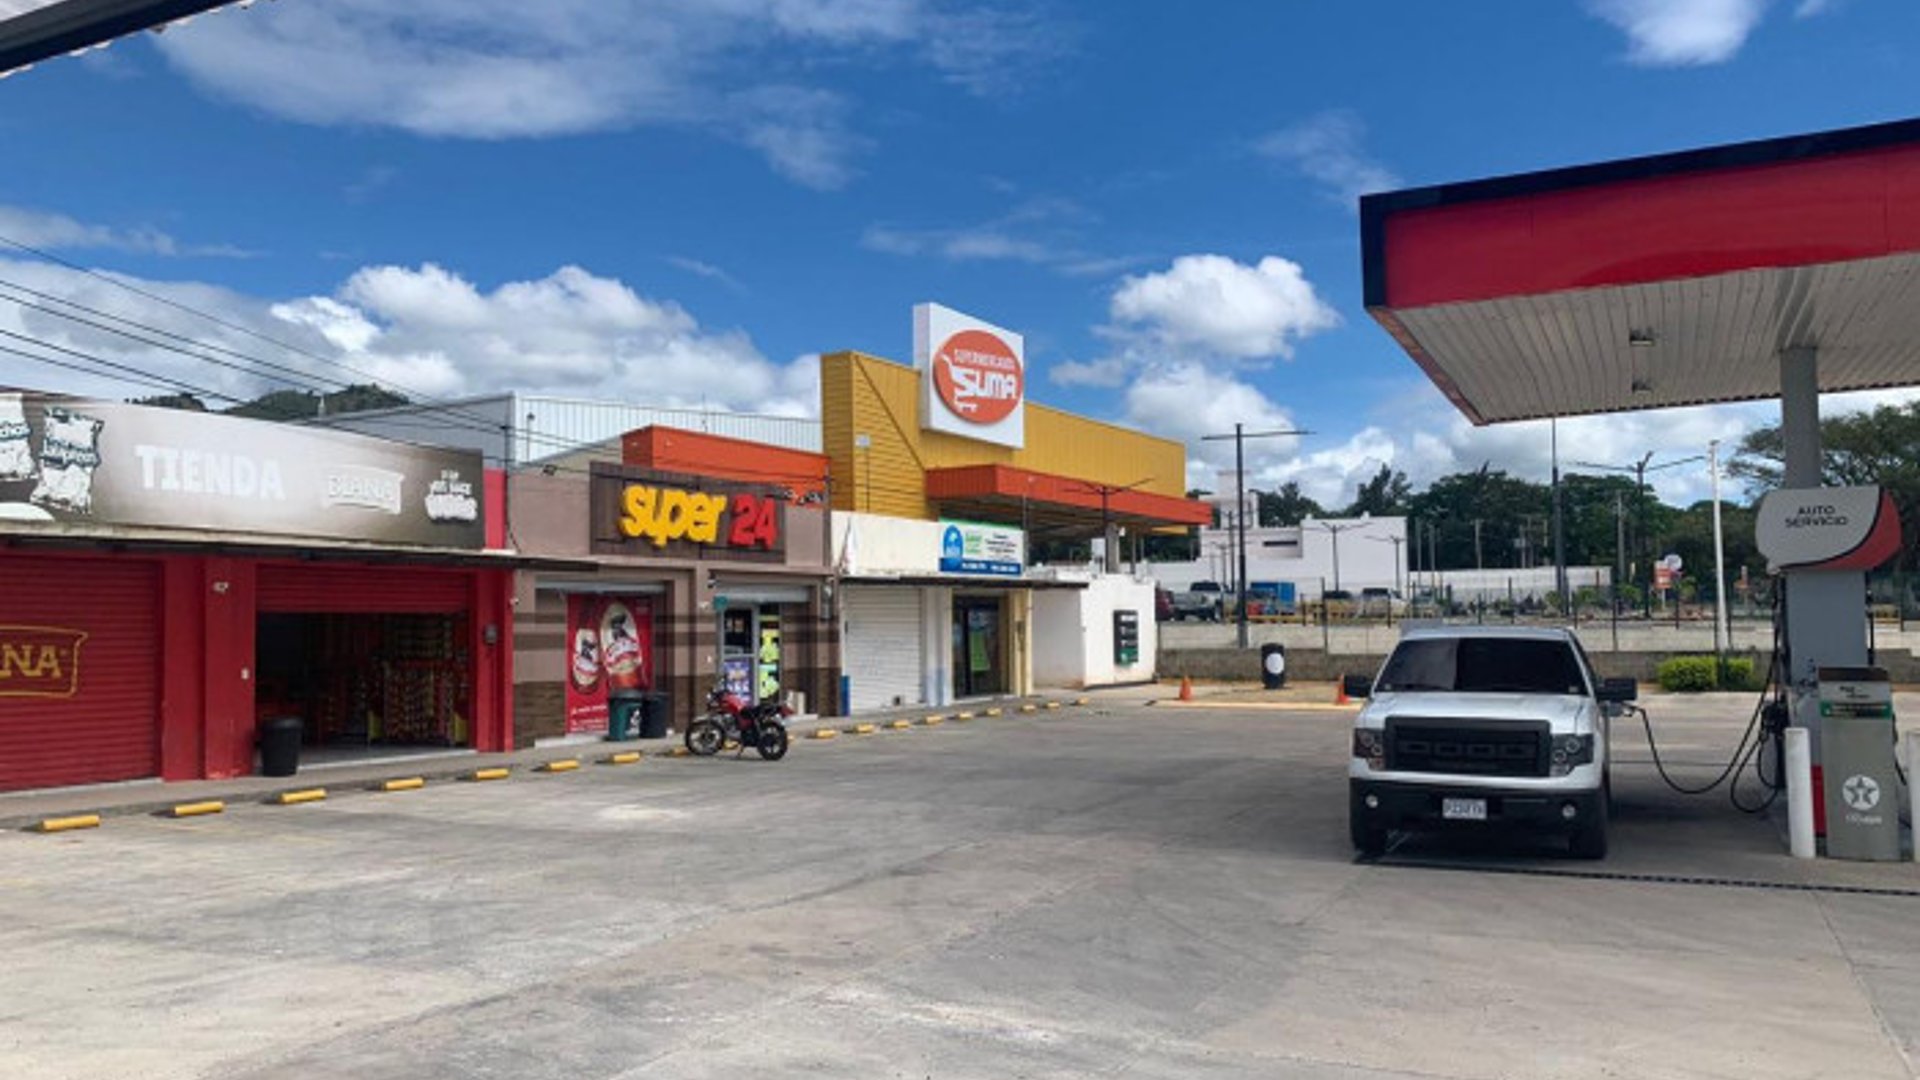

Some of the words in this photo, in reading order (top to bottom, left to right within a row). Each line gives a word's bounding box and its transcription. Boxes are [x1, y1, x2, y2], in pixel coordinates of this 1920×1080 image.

[951, 365, 1017, 400] SUMA
[134, 444, 286, 501] TIENDA
[729, 493, 778, 549] 24
[1784, 516, 1849, 528] SERVICIO
[1798, 504, 1836, 515] AUTO
[0, 644, 62, 678] NA
